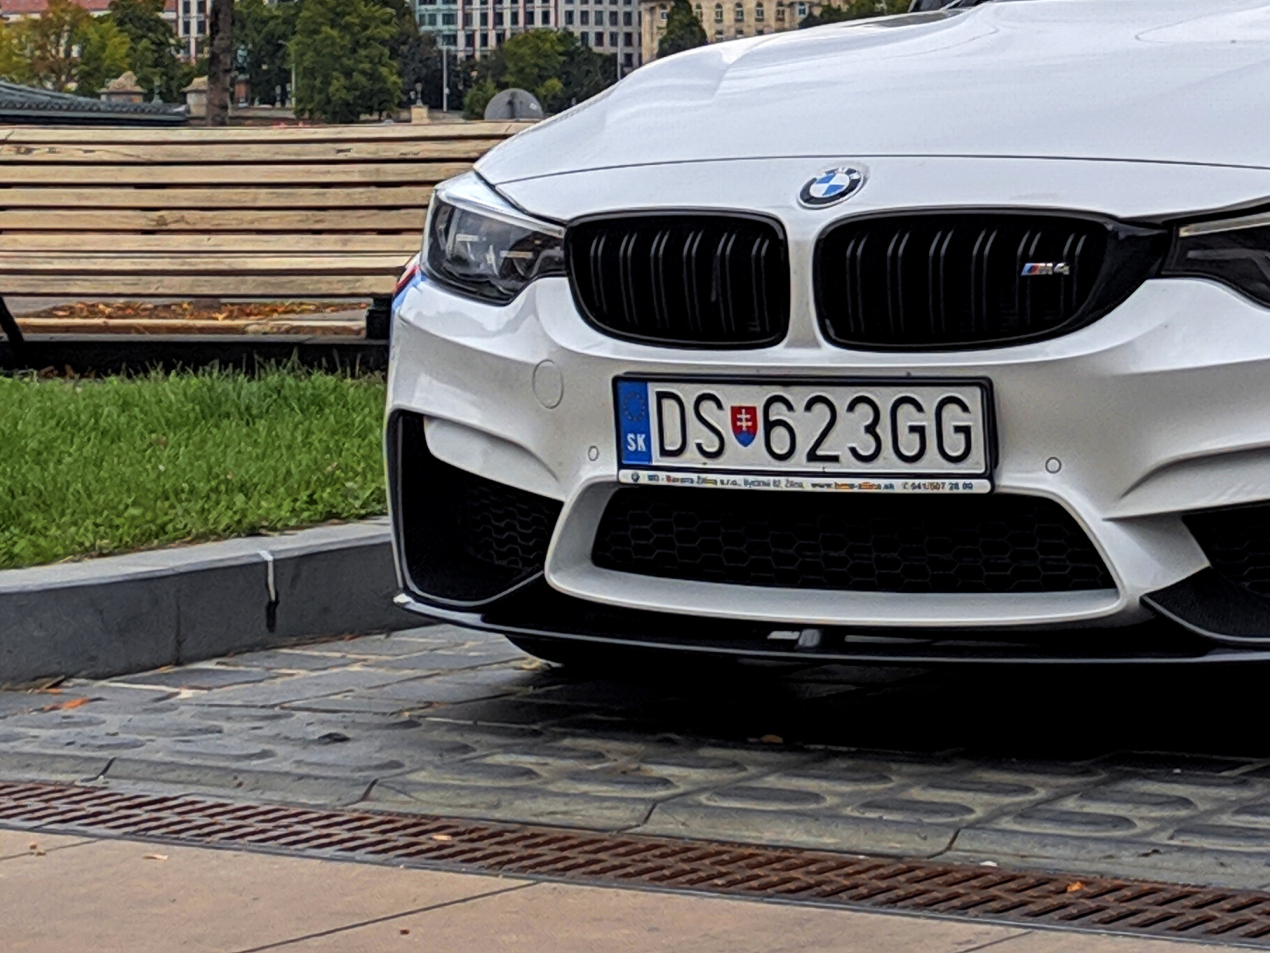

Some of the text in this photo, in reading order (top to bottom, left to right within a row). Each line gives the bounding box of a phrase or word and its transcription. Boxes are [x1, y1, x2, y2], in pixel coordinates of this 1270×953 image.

[626, 432, 647, 452] SK
[655, 390, 972, 464] DS 623GG
